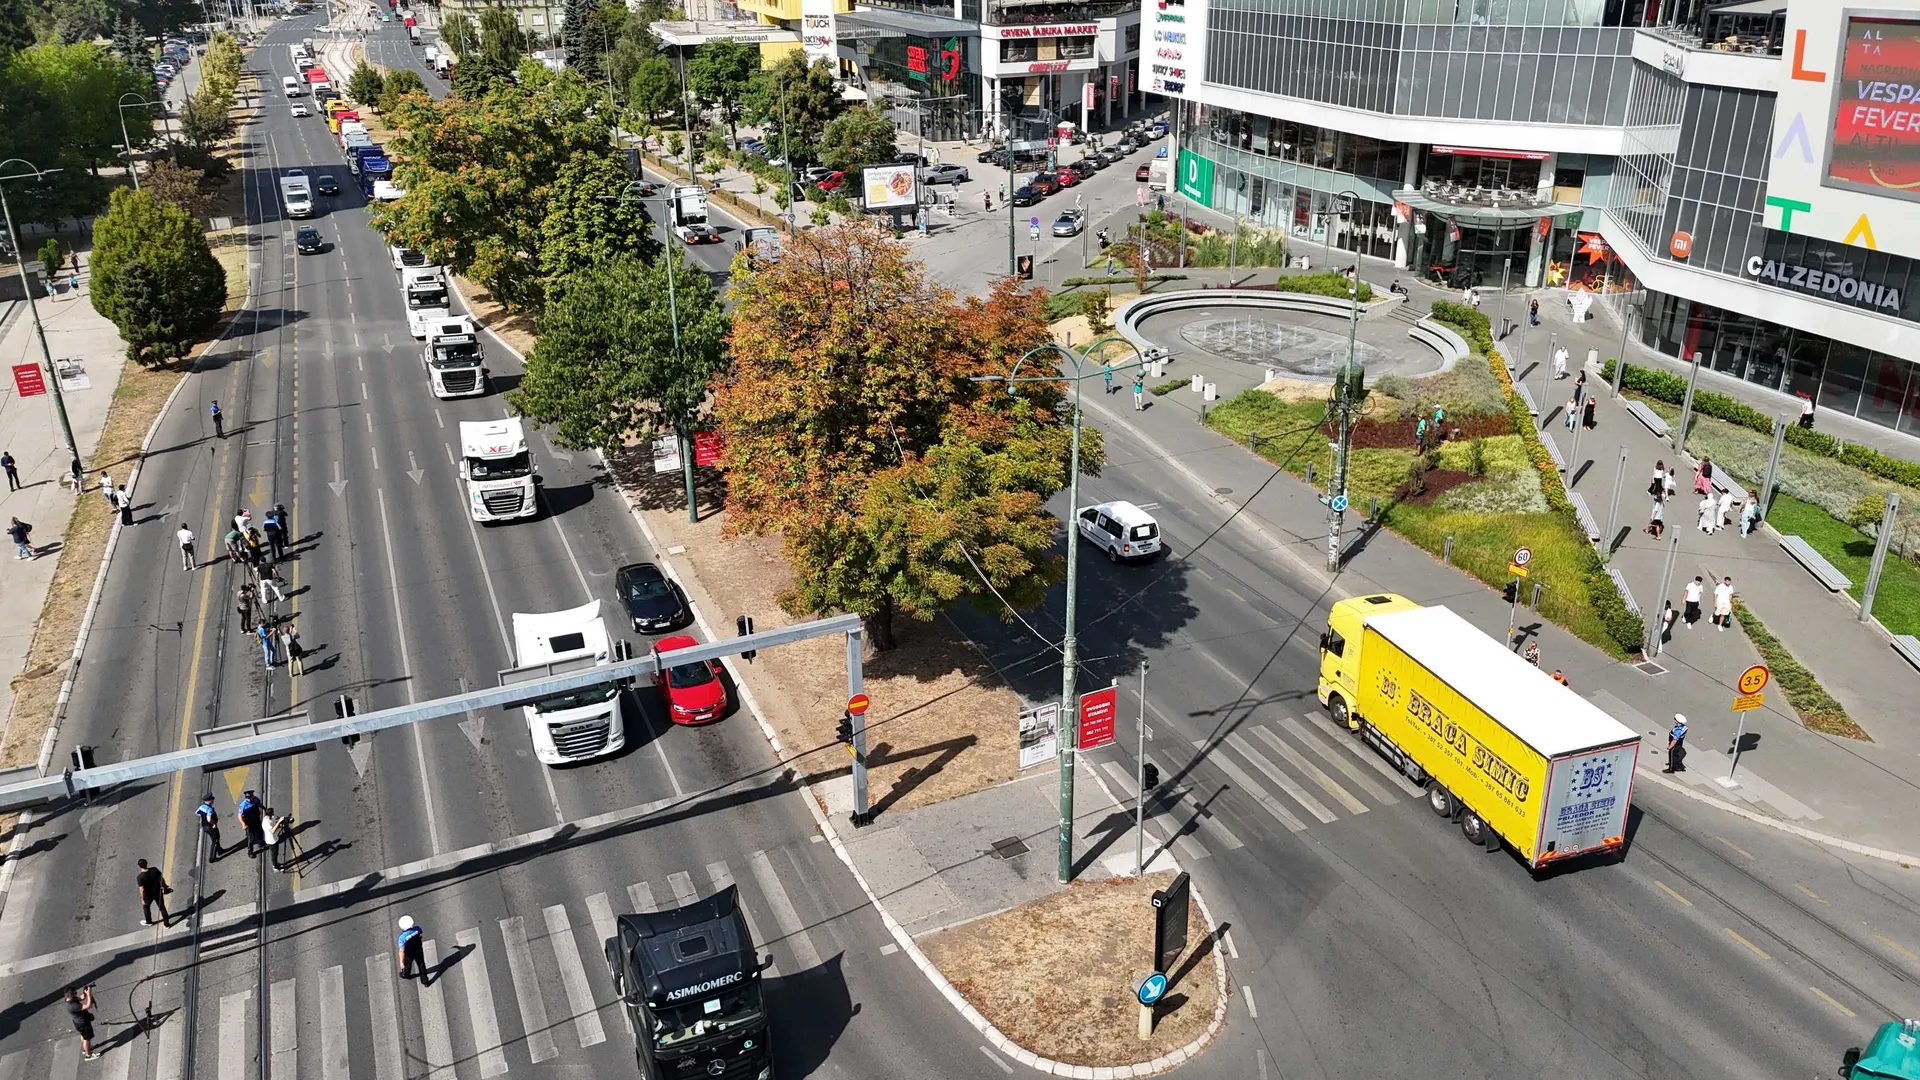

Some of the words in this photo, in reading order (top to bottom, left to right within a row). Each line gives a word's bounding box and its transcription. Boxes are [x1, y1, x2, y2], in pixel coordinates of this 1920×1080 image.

[805, 19, 830, 29] TOUCH
[1000, 28, 1031, 38] CRVENA
[1065, 25, 1098, 35] MARKET
[1852, 106, 1920, 133] FEVER
[1189, 158, 1198, 184] D
[1747, 256, 1901, 311] CALZEDONIA
[489, 445, 508, 453] XF
[1517, 552, 1528, 562] 60
[1744, 674, 1761, 687] 3.5
[1406, 690, 1467, 758] BRAĆA
[1472, 745, 1530, 803] SIMIĆ
[1427, 733, 1437, 744] 387
[1485, 781, 1495, 792] 387
[1557, 810, 1595, 822] PRIJEDOR
[666, 971, 743, 1002] ASIMKOMERC
